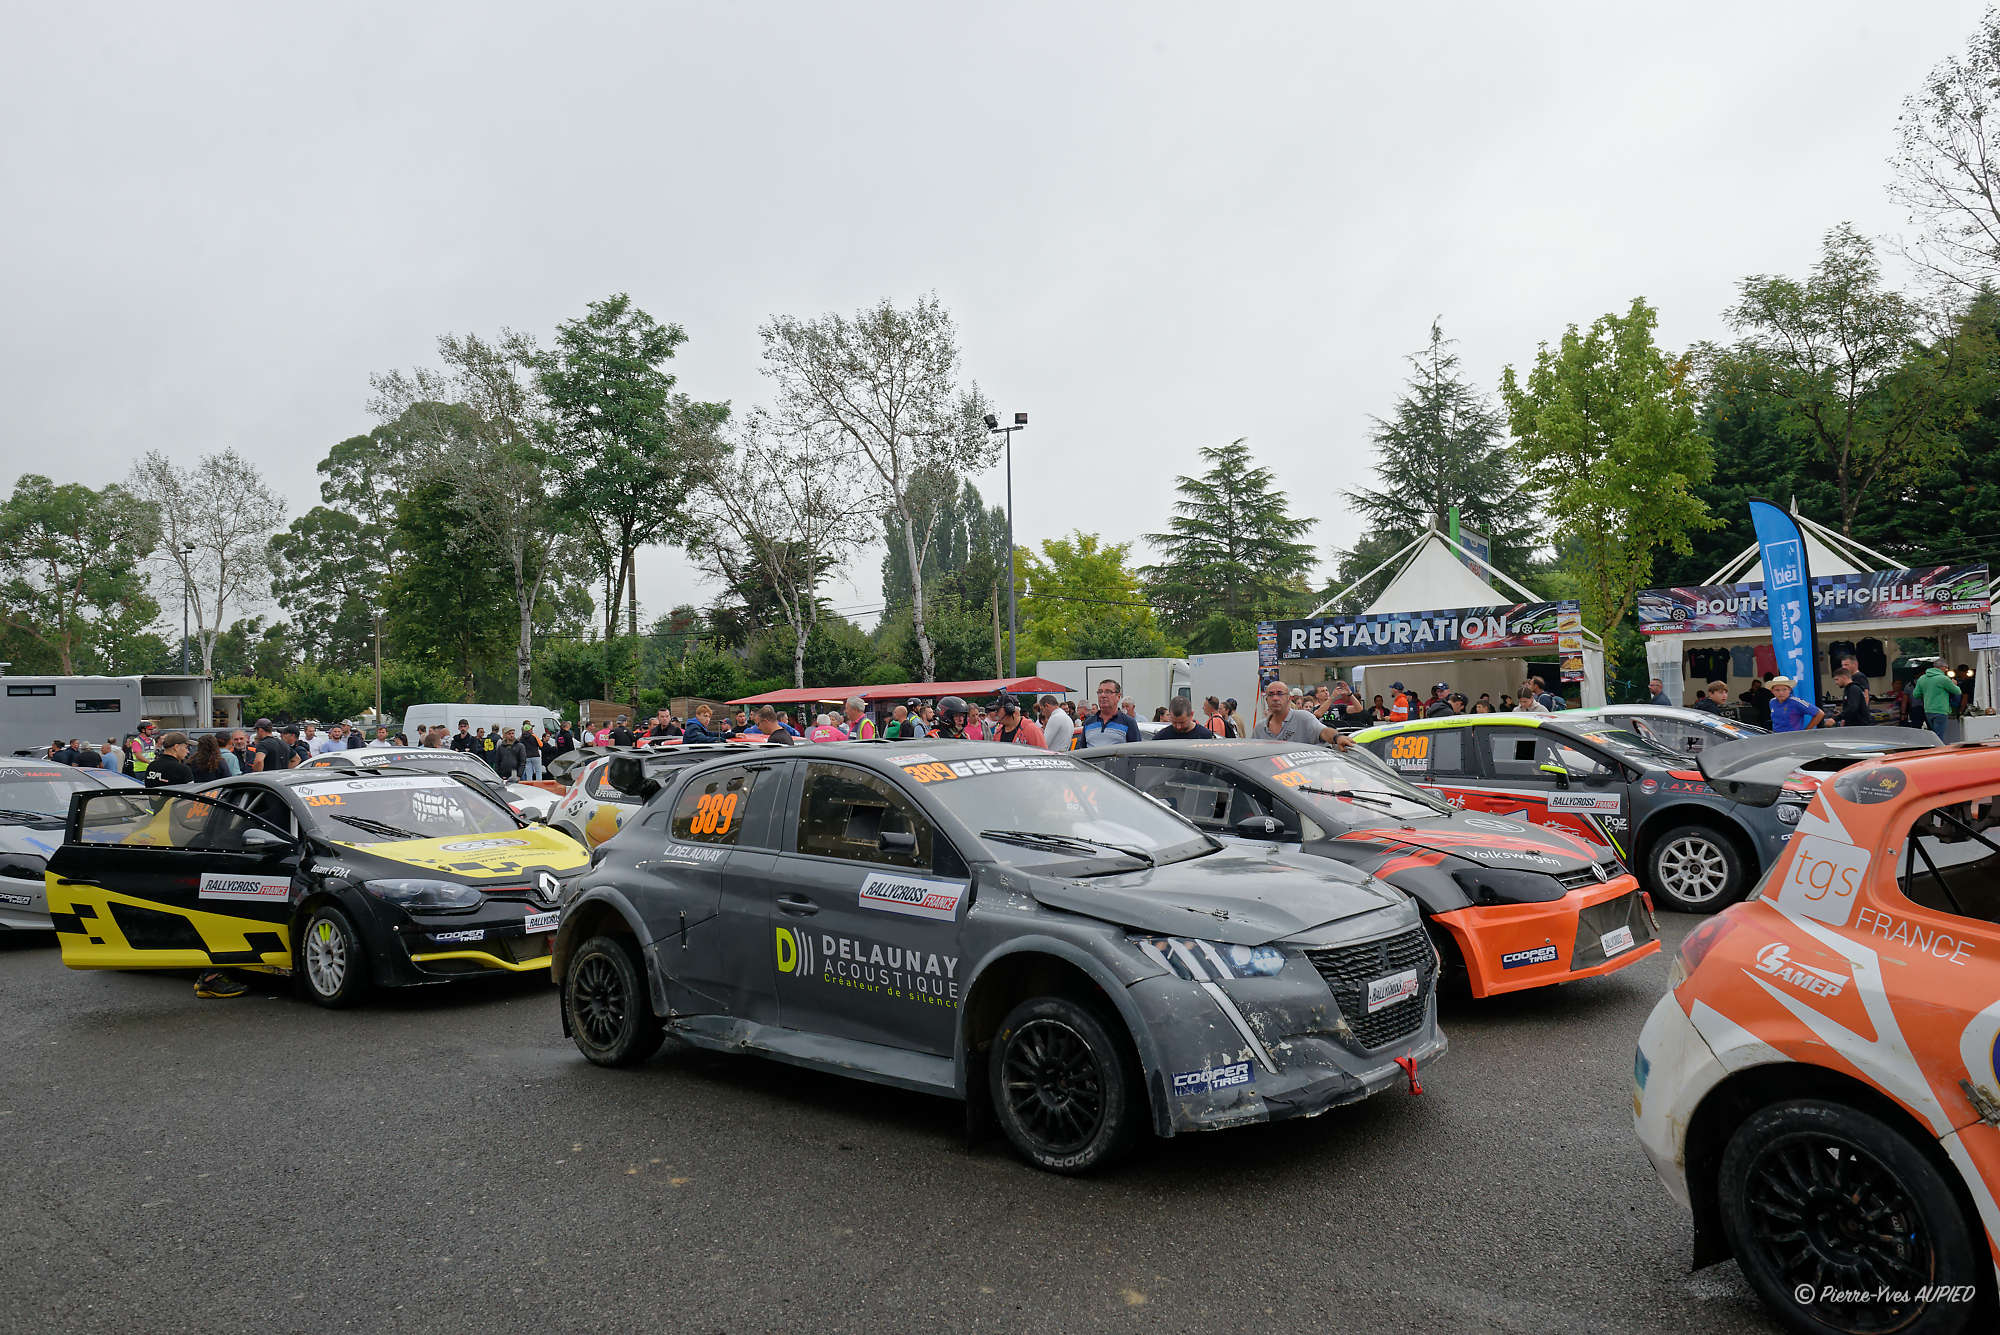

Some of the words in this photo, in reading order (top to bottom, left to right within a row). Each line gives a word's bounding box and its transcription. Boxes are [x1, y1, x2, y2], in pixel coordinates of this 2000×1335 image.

[1291, 615, 1508, 650] RESTAURATION
[1391, 736, 1429, 759] 330
[904, 762, 958, 784] 389
[306, 794, 347, 807] 342
[1551, 796, 1597, 807] RALLYCROSS
[690, 793, 738, 835] 389
[664, 844, 724, 862] L.DELAUNAY
[1466, 850, 1562, 867] Volkswagen
[1795, 850, 1859, 901] tgs
[204, 879, 261, 893] RALLYCROSS
[259, 886, 288, 897] FRANCE
[865, 881, 927, 902] RALLYCROSS
[922, 894, 959, 911] FRANCE
[436, 929, 485, 940] COOPER
[1855, 906, 1976, 966] FRANCE
[822, 934, 959, 978] DELAUNAY
[1503, 946, 1556, 962] COOPER
[1529, 955, 1556, 963] TIRES
[824, 958, 958, 999] ACOUSTIQUE
[1755, 945, 1842, 998] SAMEP
[824, 973, 880, 993] Créateur
[887, 986, 901, 997] de
[910, 992, 959, 1009] silence
[1174, 1063, 1249, 1087] COOPER
[1212, 1073, 1249, 1088] TIRES
